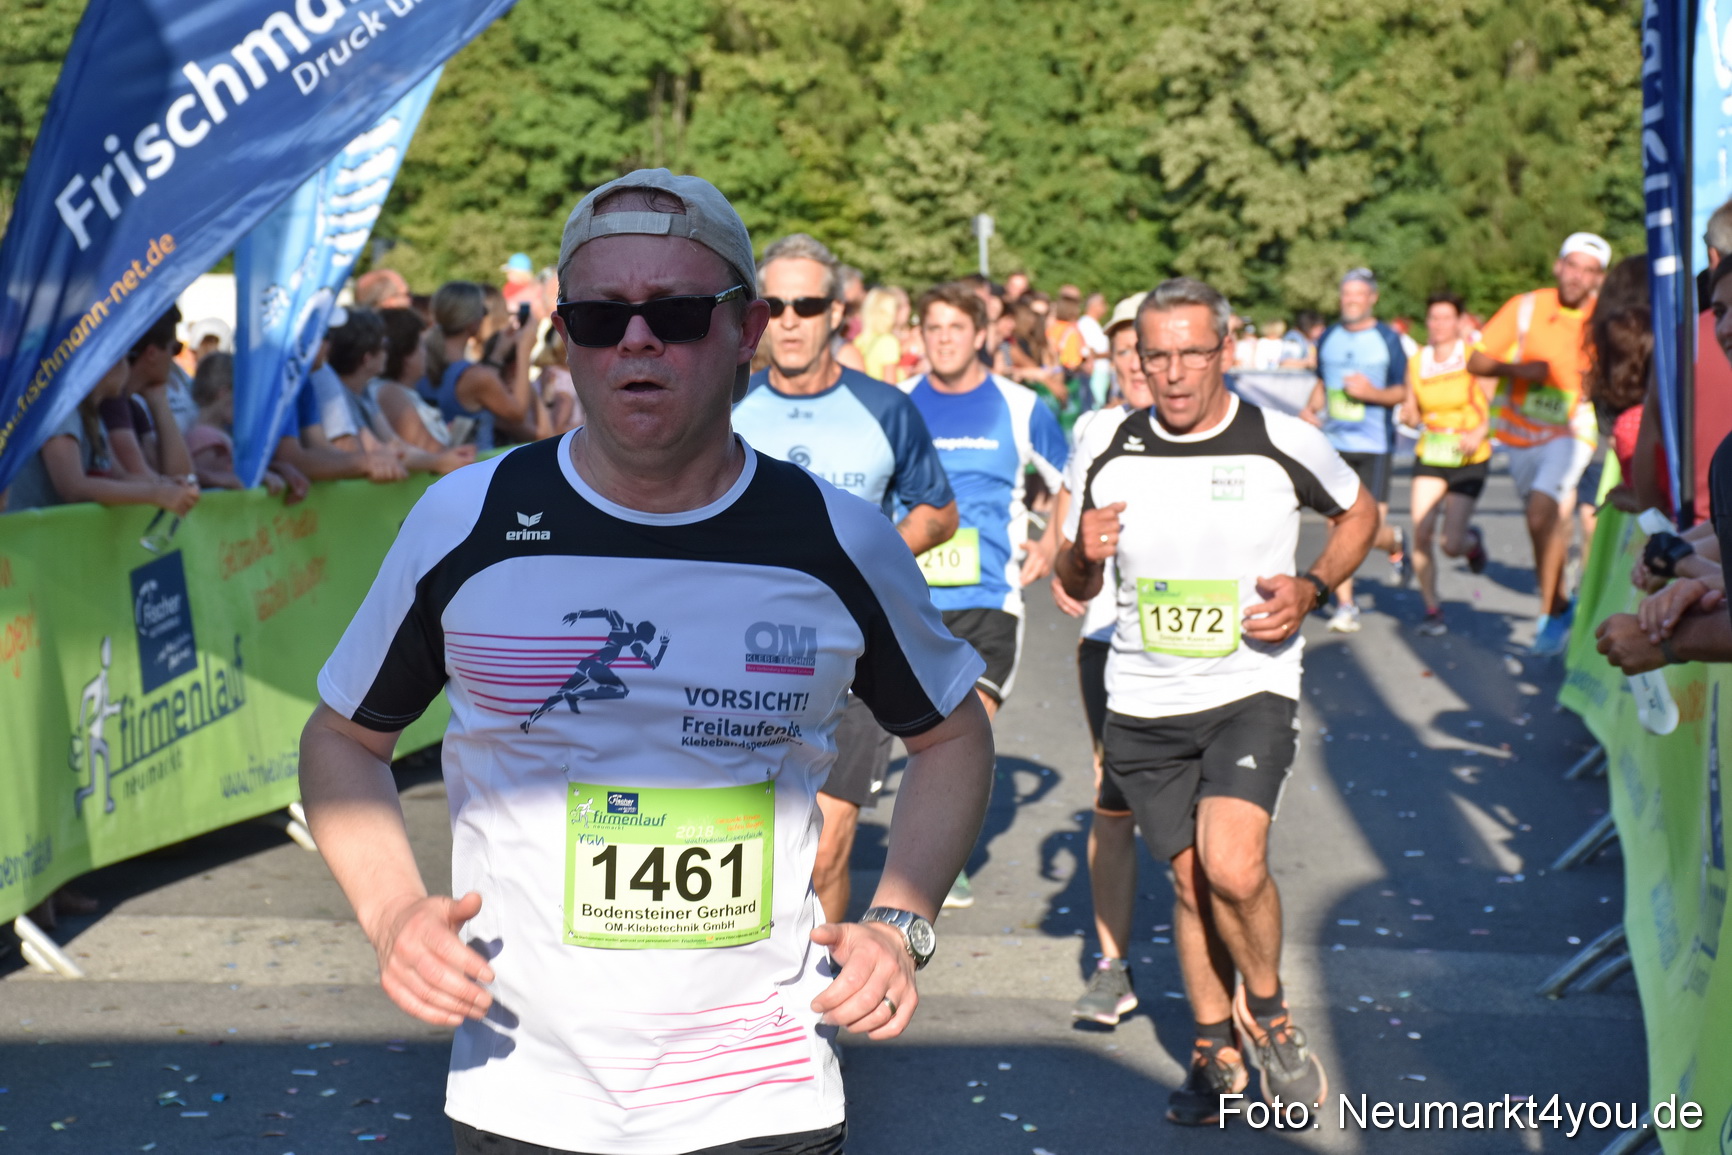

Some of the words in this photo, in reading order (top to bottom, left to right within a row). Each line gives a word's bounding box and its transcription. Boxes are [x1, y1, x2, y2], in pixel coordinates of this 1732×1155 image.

[291, 10, 388, 96] Druck
[55, 0, 360, 250] Frischma
[505, 528, 551, 541] erima
[923, 551, 961, 568] 210
[1150, 606, 1224, 633] 1372
[744, 621, 818, 657] OM
[746, 654, 776, 663] KLEBE
[777, 656, 816, 666] TECHNIK
[120, 633, 247, 768] firmenlauf
[684, 687, 810, 712] VORSICHT!
[682, 716, 802, 737] Freilaufende
[593, 810, 667, 827] firmenlauf
[675, 825, 715, 839] 2018
[592, 843, 743, 902] 1461
[582, 903, 692, 920] Bodensteiner
[697, 900, 756, 919] Gerhard
[604, 922, 700, 933] OM-Klebetechnik
[703, 920, 735, 931] GmbH
